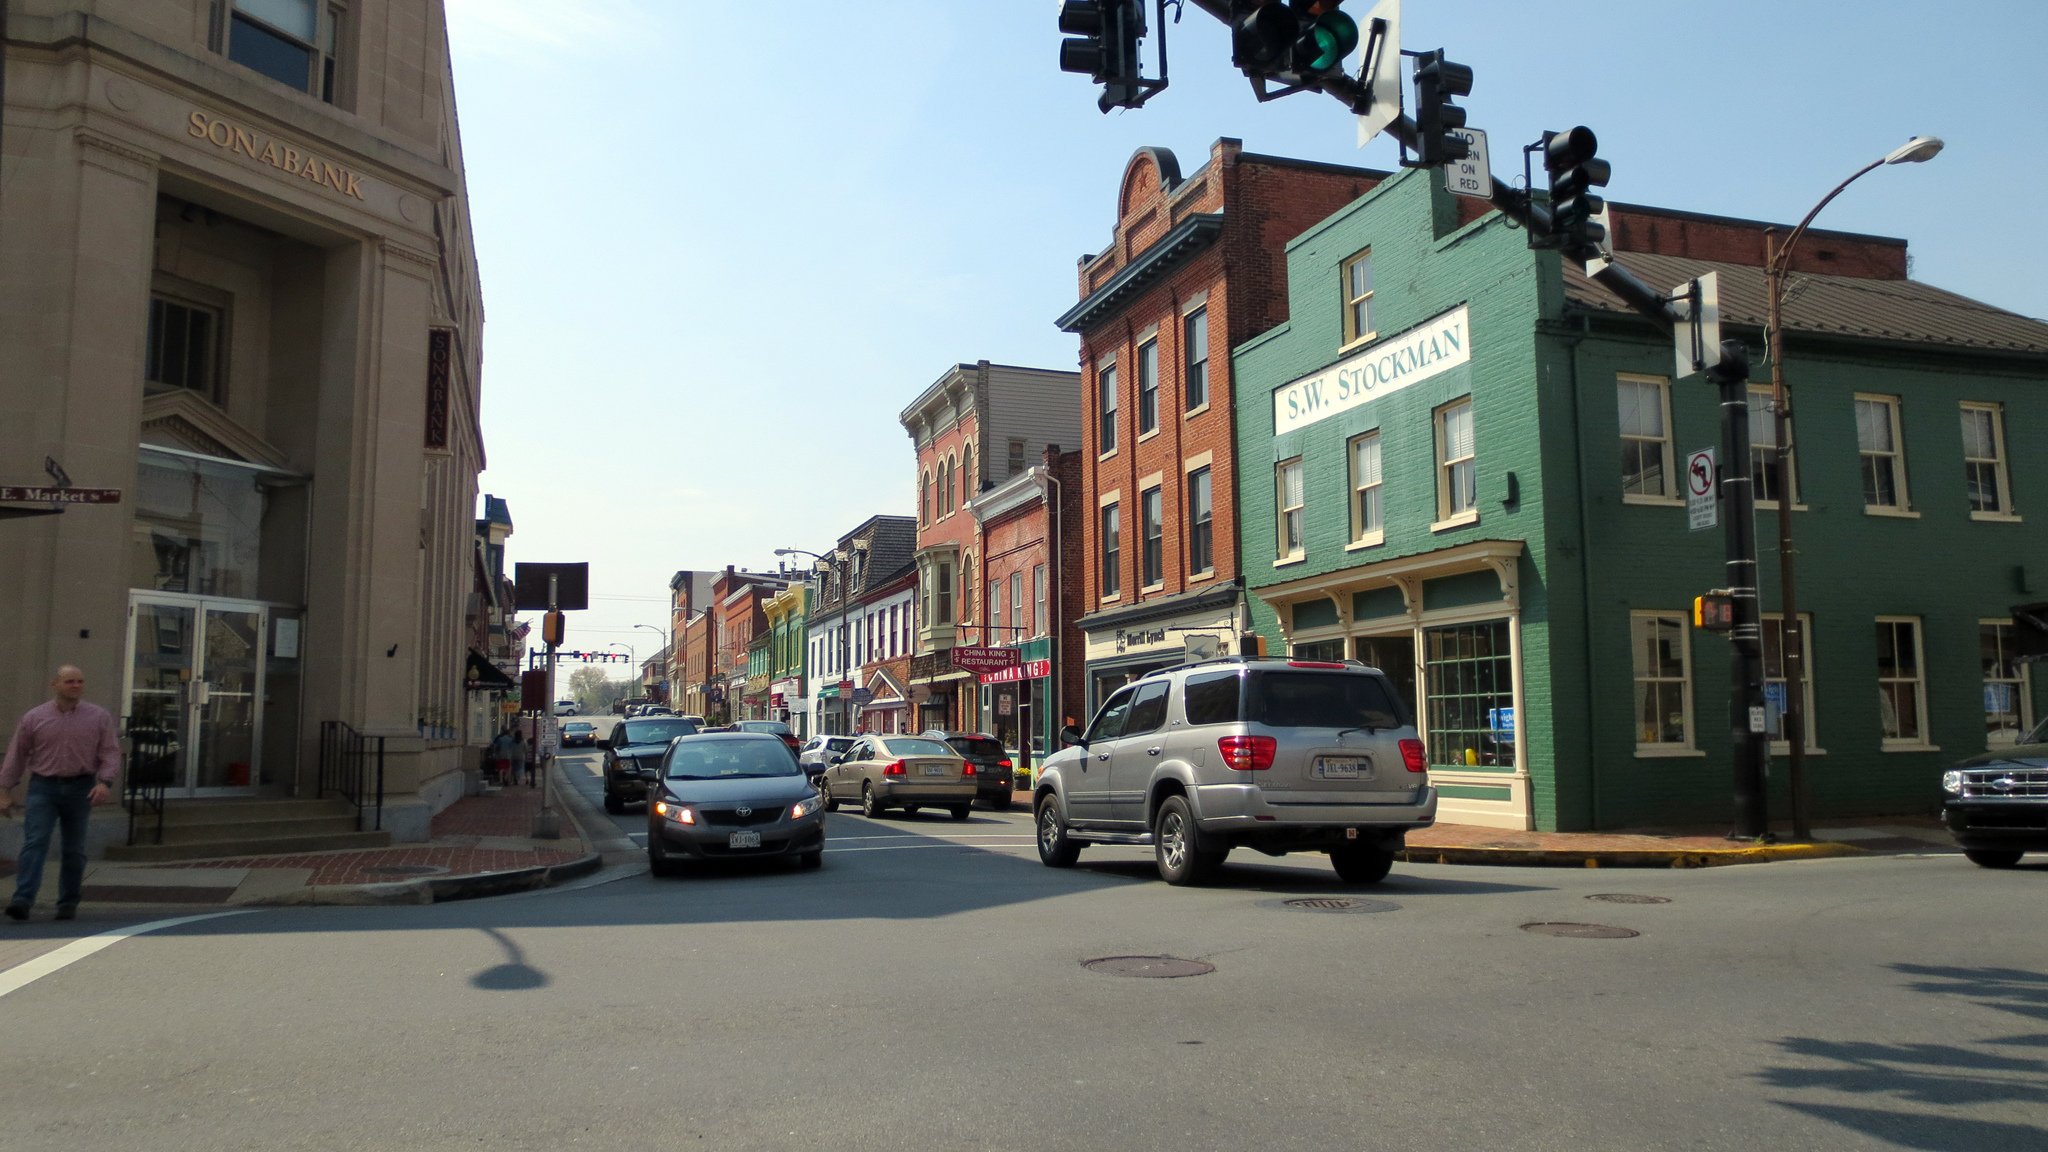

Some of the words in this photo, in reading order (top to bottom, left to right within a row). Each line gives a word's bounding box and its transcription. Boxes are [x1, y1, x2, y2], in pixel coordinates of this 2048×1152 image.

[188, 111, 366, 201] SONABANK
[1461, 163, 1476, 176] ON
[1460, 177, 1479, 191] RED
[1288, 378, 1330, 420] S.W.
[1338, 323, 1462, 401] STOCKMAN
[432, 336, 446, 440] SONABANK
[1, 488, 18, 500] E.
[25, 488, 85, 502] Market
[1146, 628, 1164, 645] Lynch
[963, 649, 987, 657] CHINA
[961, 658, 1008, 667] RESTAURANT
[988, 668, 1014, 682] CHINA
[1017, 663, 1039, 679] KING
[1326, 763, 1357, 773] JKL-9638
